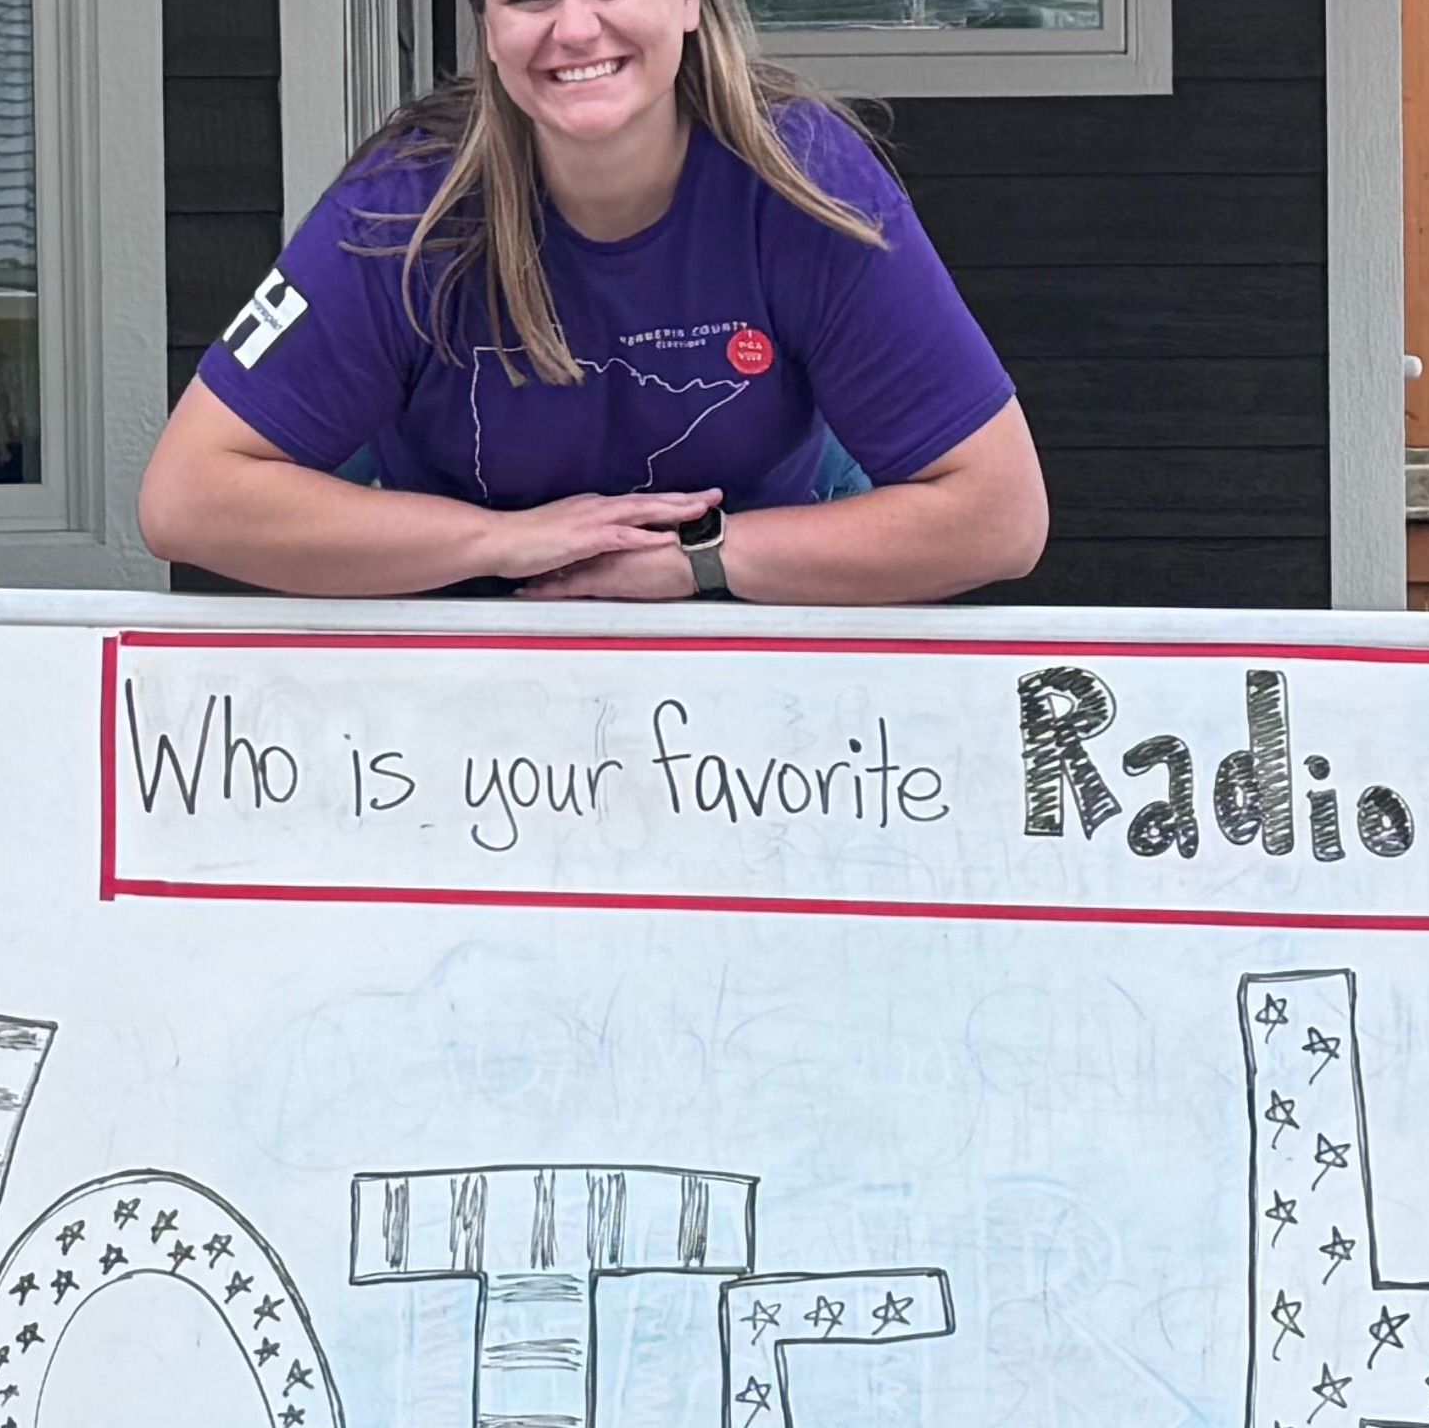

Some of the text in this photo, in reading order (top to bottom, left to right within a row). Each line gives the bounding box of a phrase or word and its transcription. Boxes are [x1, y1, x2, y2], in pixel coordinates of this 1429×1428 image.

[125, 679, 297, 814] Who
[343, 733, 416, 817] is
[463, 752, 623, 852] your
[651, 698, 951, 829] favorite
[1018, 665, 1415, 863] Radio
